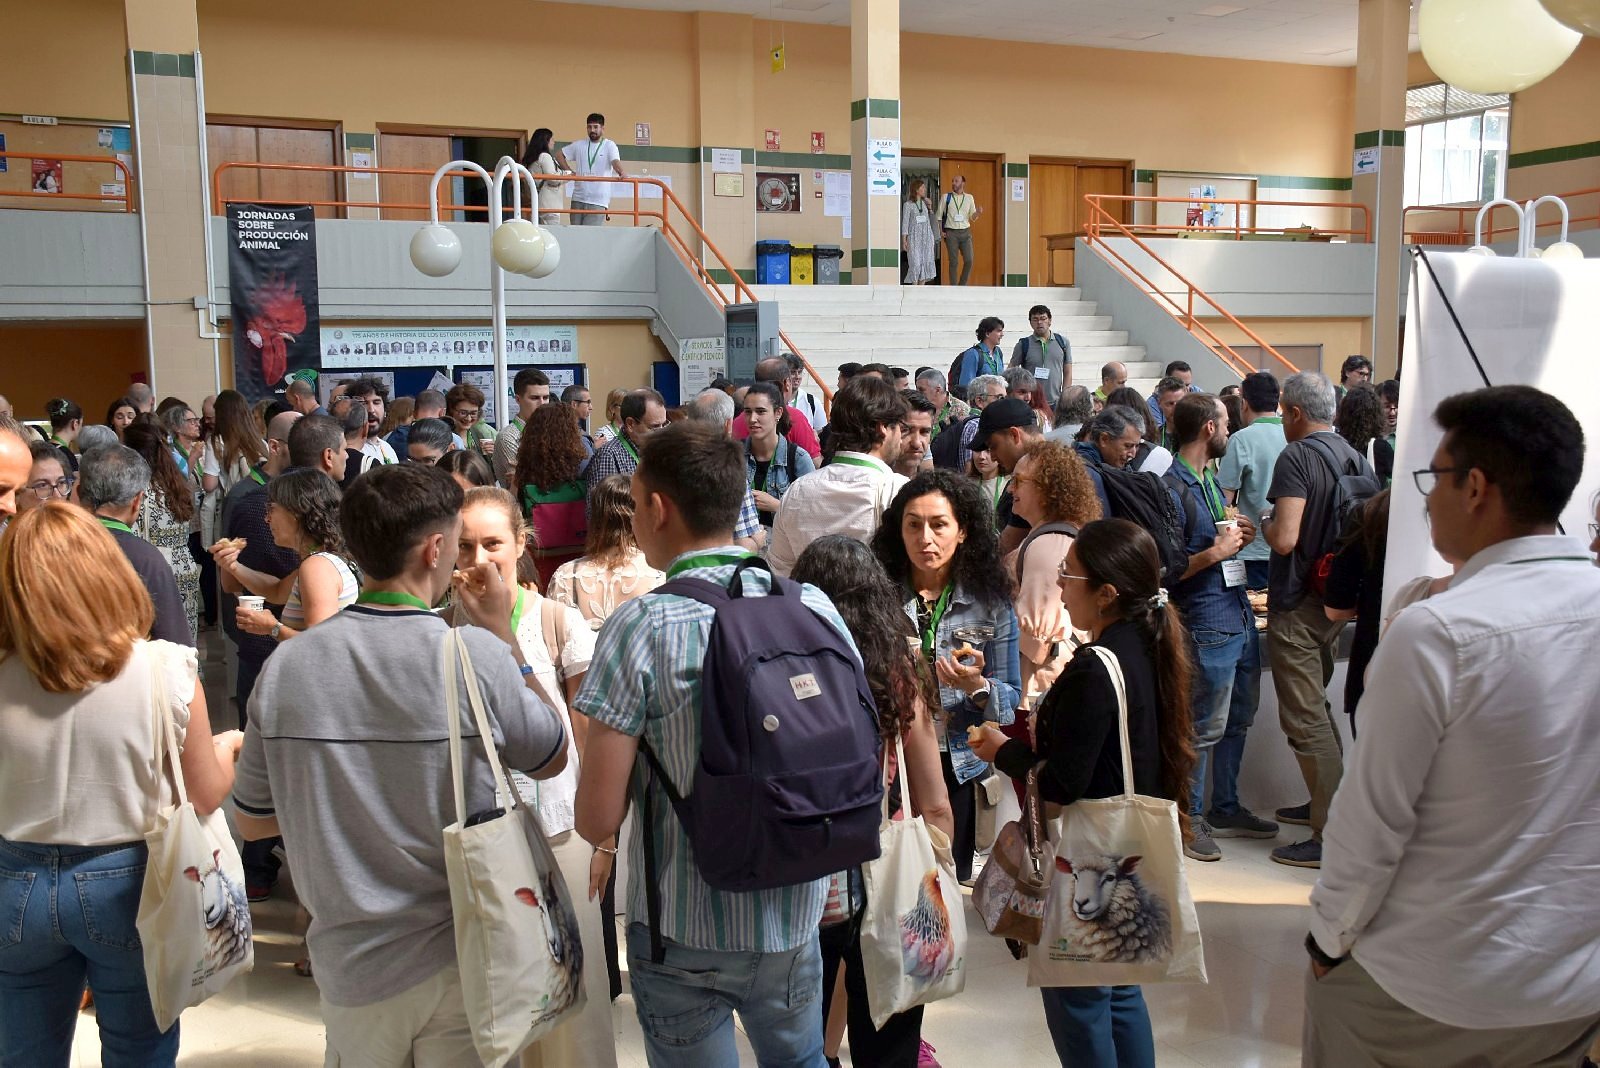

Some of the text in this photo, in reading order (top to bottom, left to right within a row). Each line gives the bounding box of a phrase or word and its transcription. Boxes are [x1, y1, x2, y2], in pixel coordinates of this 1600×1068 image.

[237, 211, 296, 221] JORNADAS
[238, 220, 275, 230] SOBRE
[238, 230, 309, 241] PRODUCCIÓN
[239, 240, 281, 250] ANIMAL
